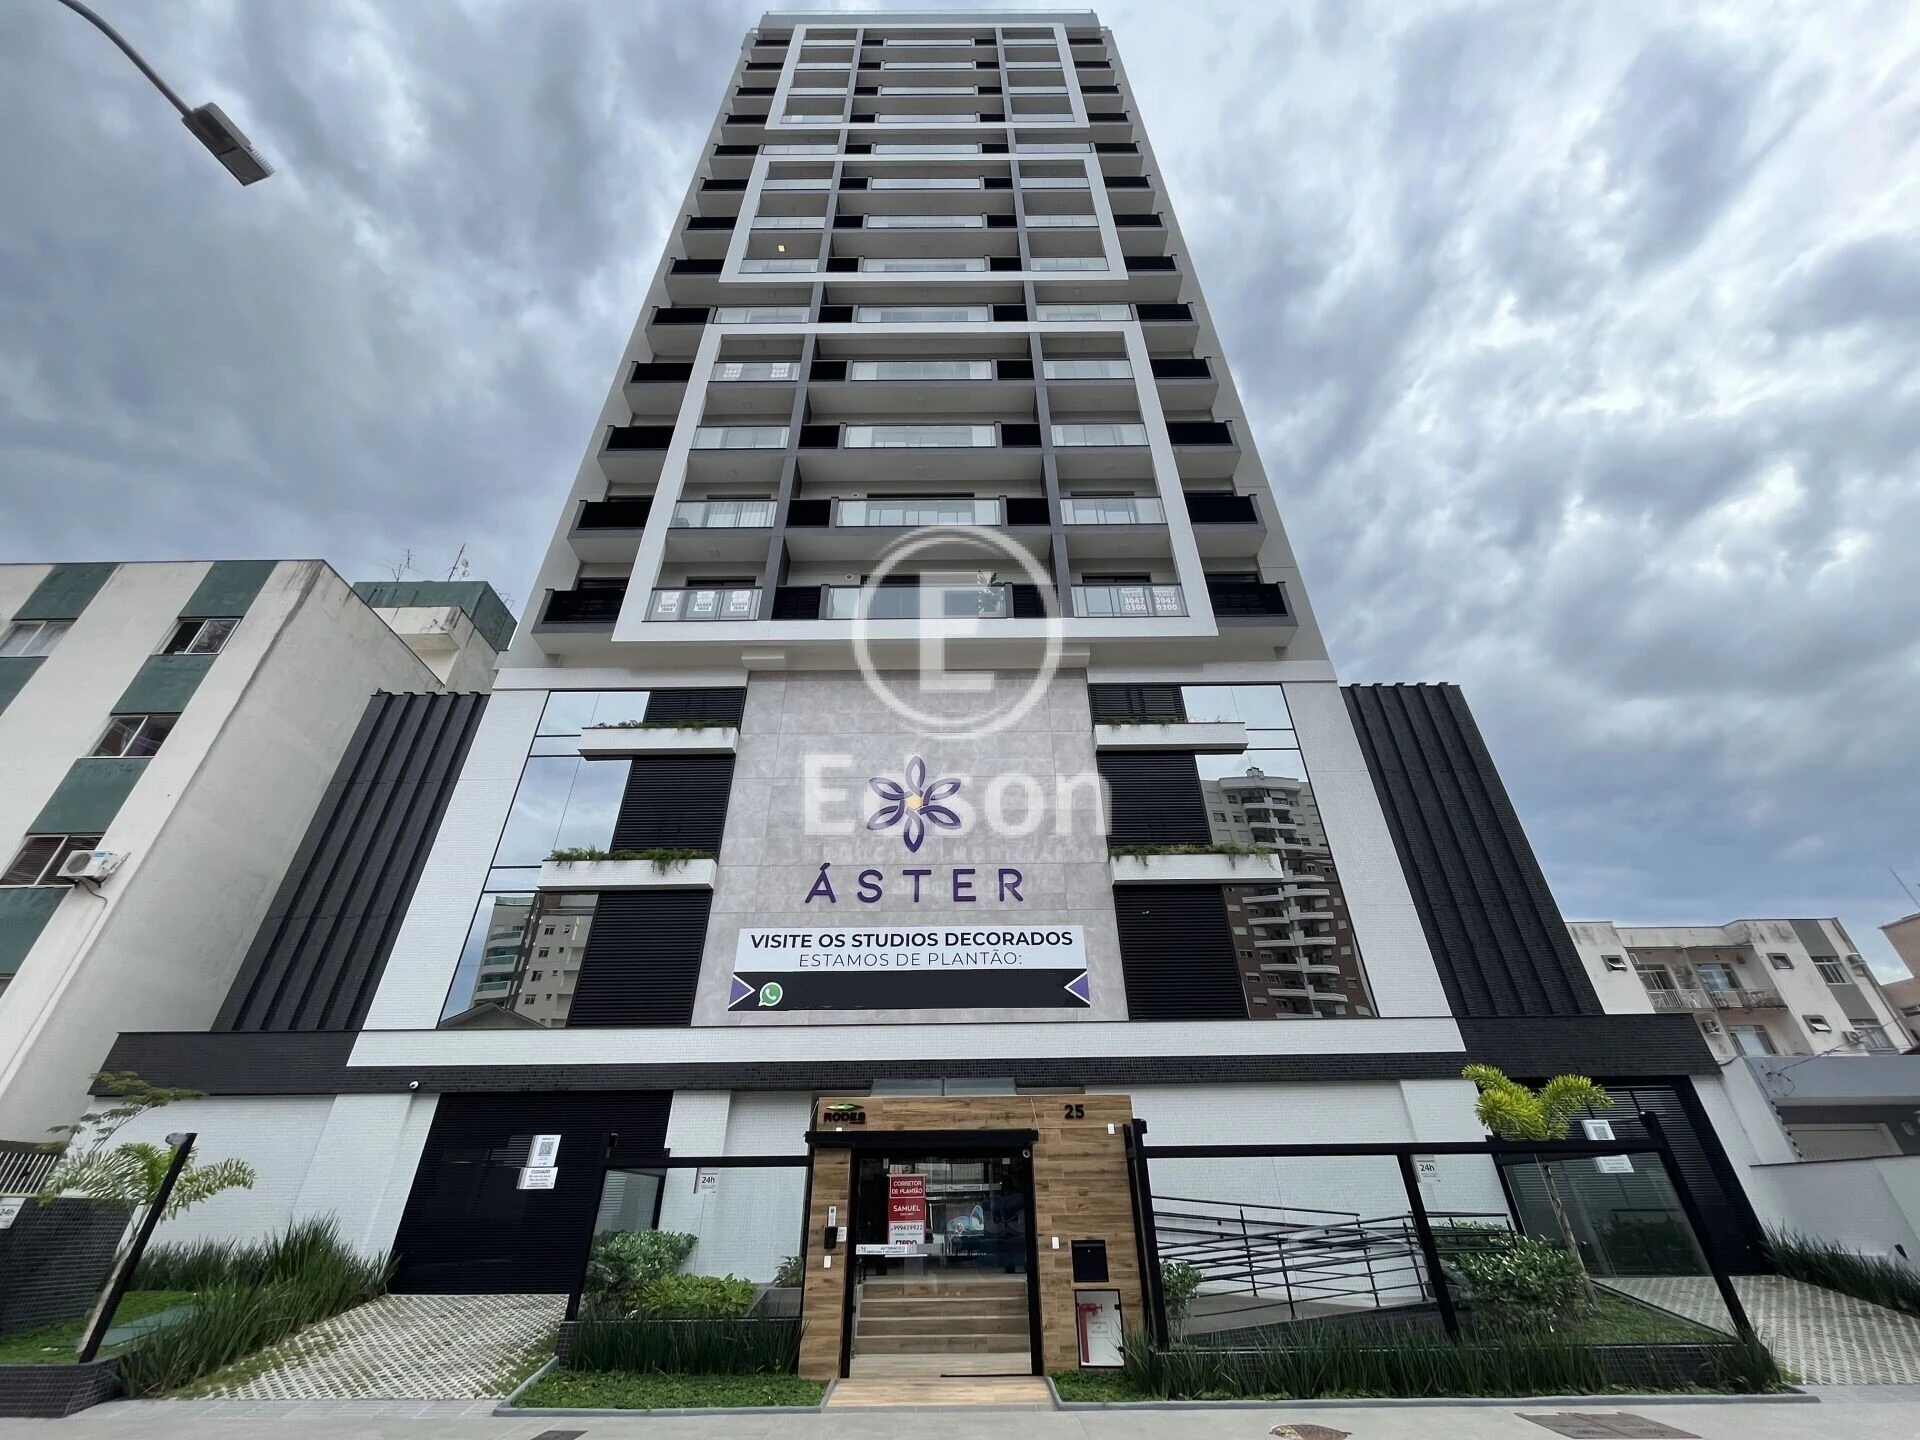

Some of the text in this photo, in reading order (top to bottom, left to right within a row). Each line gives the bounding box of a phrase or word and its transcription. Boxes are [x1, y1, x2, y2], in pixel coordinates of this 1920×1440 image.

[1125, 603, 1146, 611] 0300
[1156, 603, 1178, 611] 0300
[804, 862, 1024, 904] ÁSTER
[750, 931, 1073, 949] VISITE OS STUDIOS DECORADOS
[799, 948, 1023, 968] ESTAMOS DE PLANTÃO:
[824, 1111, 867, 1123] RODES
[1064, 1104, 1085, 1120] 25
[1420, 1164, 1435, 1172] 24h
[701, 1176, 716, 1184] 24h
